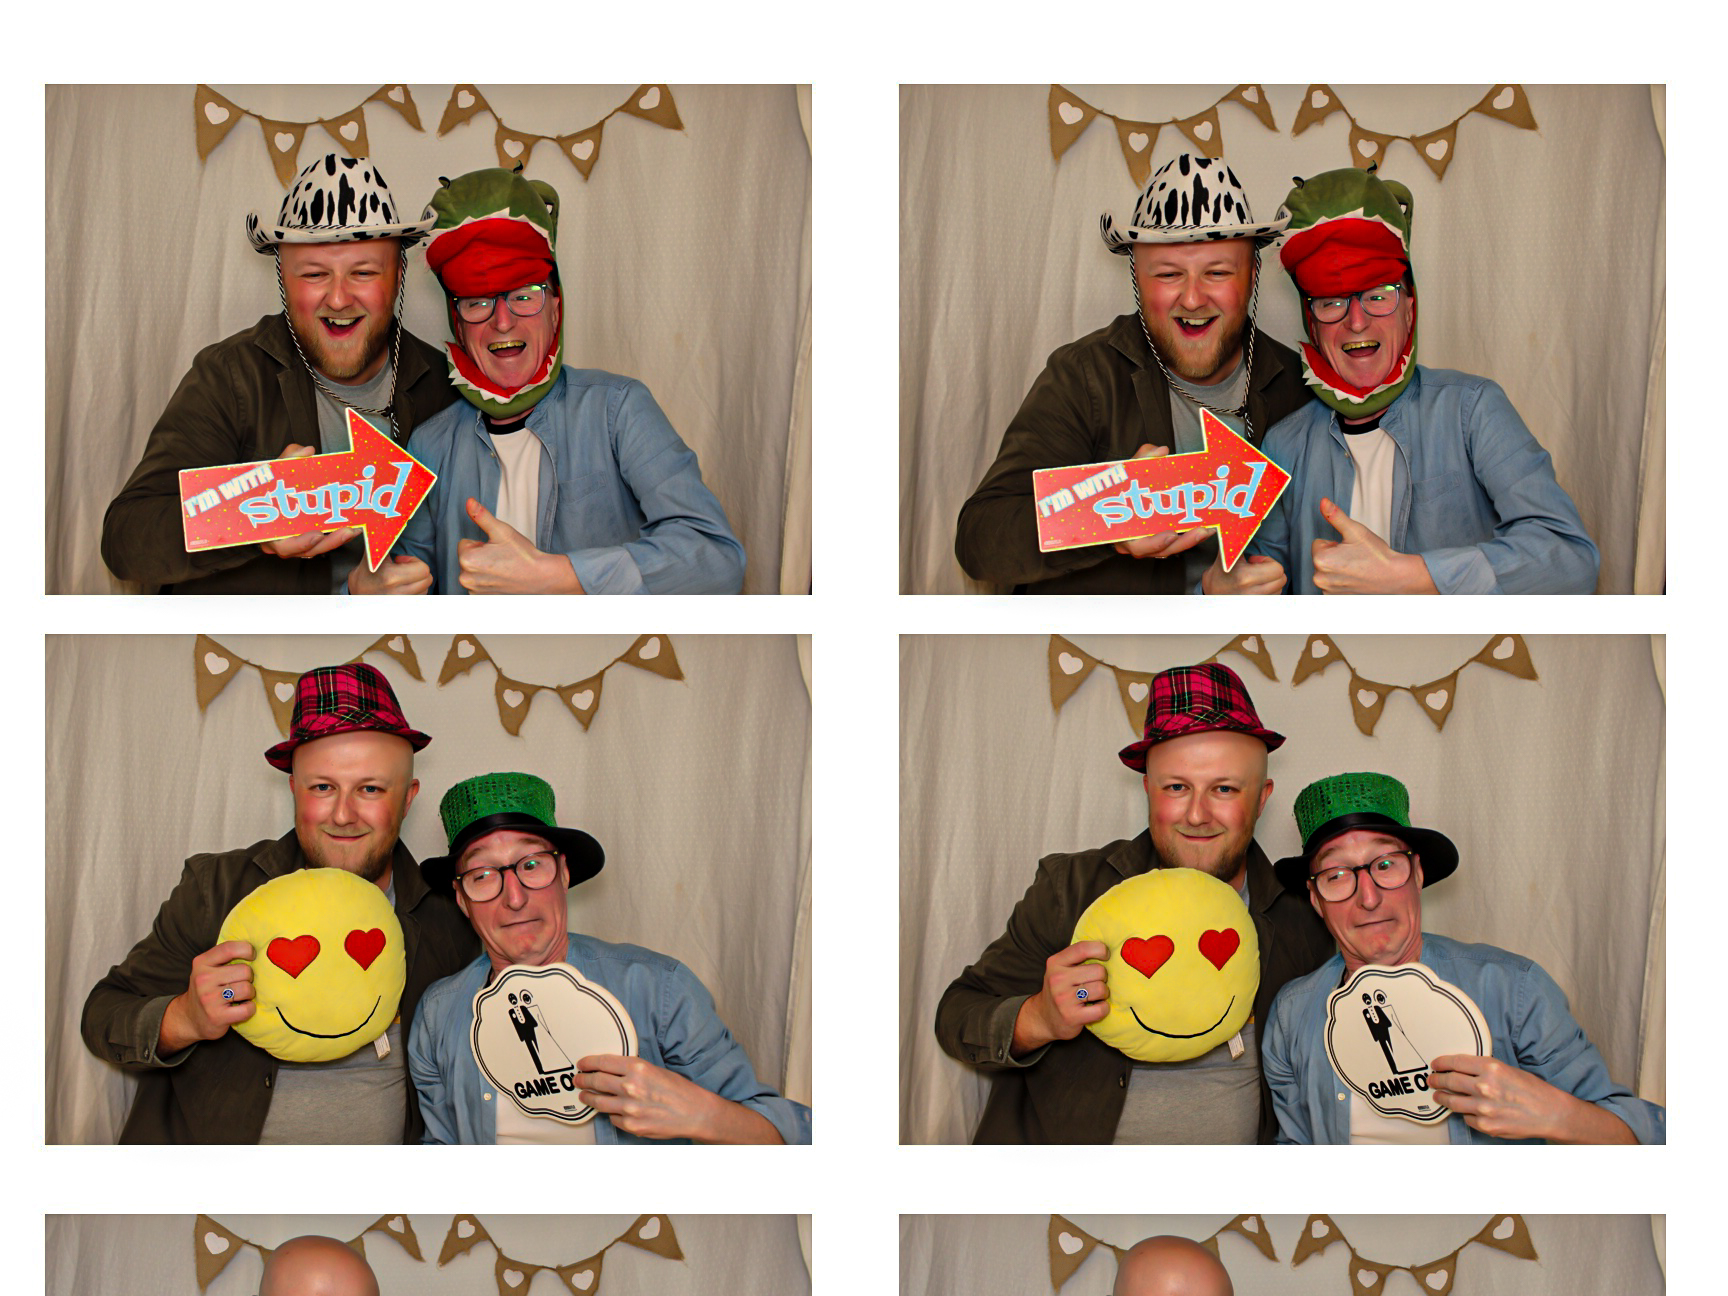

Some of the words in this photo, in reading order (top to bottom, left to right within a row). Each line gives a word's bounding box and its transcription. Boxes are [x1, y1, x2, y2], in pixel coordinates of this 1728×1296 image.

[217, 462, 275, 501] WITH
[238, 461, 414, 529] stupid
[1071, 462, 1129, 501] WITH
[1092, 461, 1268, 529] stupid
[514, 1076, 561, 1099] GAME
[1368, 1076, 1415, 1099] GAME
